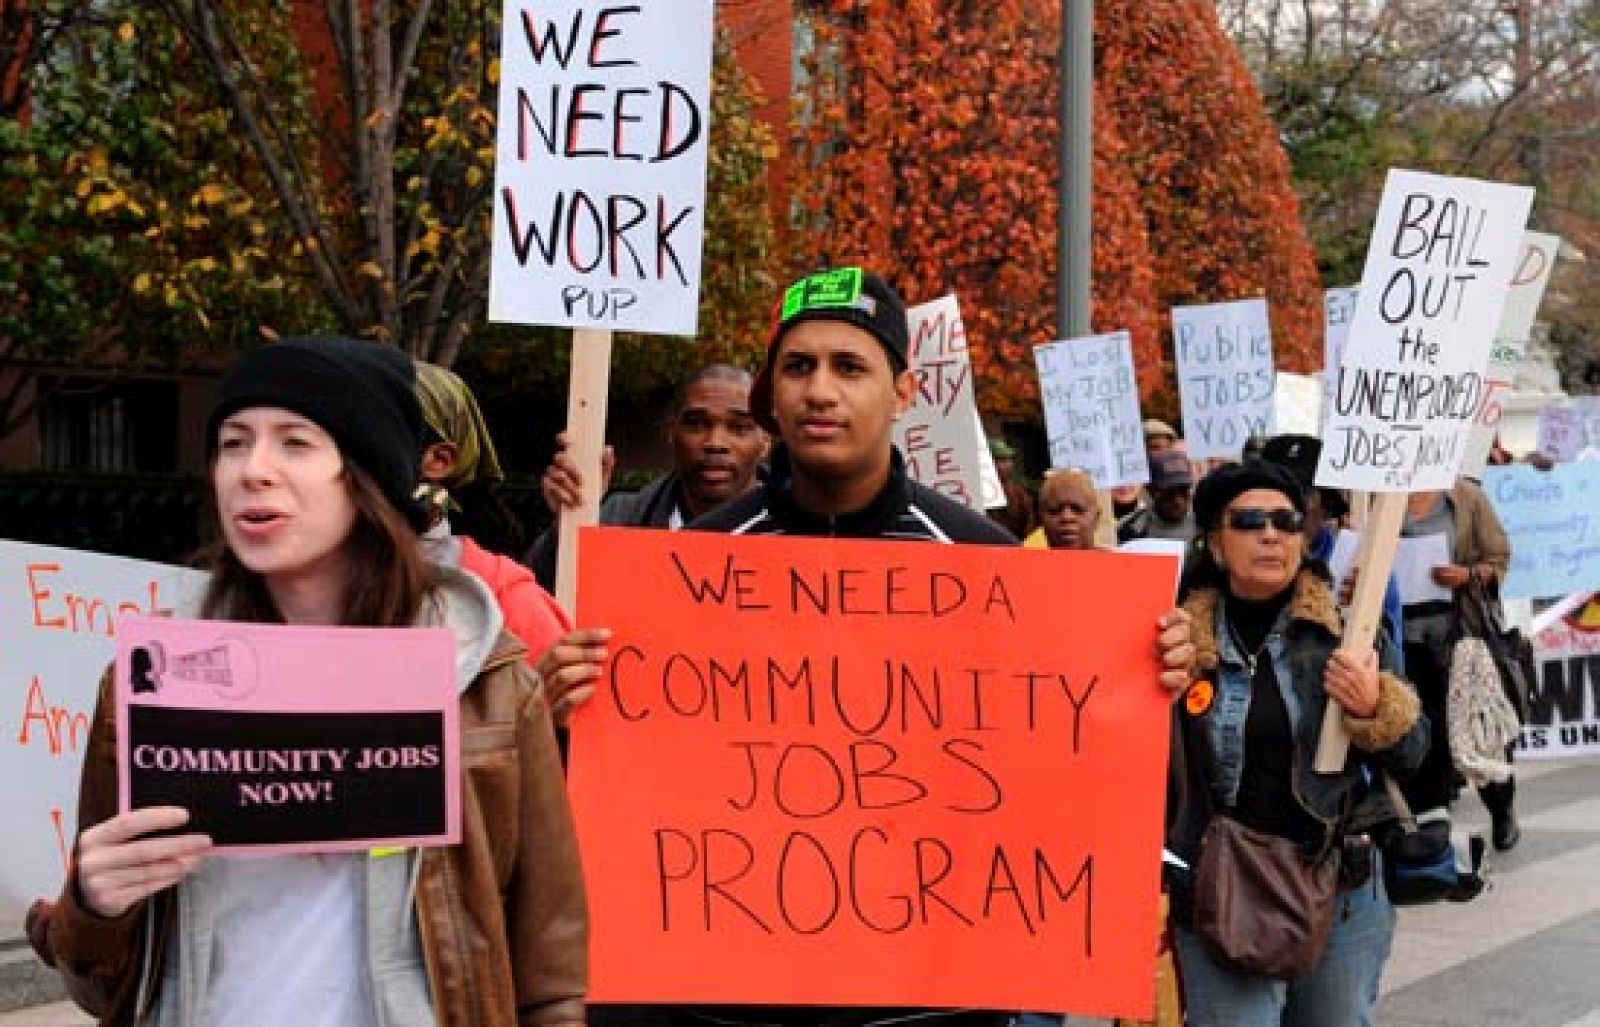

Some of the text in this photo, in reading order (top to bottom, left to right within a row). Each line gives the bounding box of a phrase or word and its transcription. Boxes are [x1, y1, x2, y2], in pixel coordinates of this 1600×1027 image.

[520, 5, 641, 70] WE
[517, 81, 702, 163] NEED
[502, 186, 694, 287] WORK
[1391, 193, 1489, 267] BAIL
[561, 284, 637, 320] PUP
[1378, 267, 1476, 324] OUT
[1397, 326, 1440, 365] the
[1190, 370, 1275, 410] JOBS
[1329, 425, 1405, 471] JOBS
[670, 551, 1017, 622] WE NEED A
[609, 645, 1099, 755] COMMUNITY
[133, 744, 440, 774] COMMUNITY JOBS
[726, 738, 1003, 819] JOBS
[239, 781, 333, 807] NOW!
[653, 825, 1096, 959] PROGRAM
